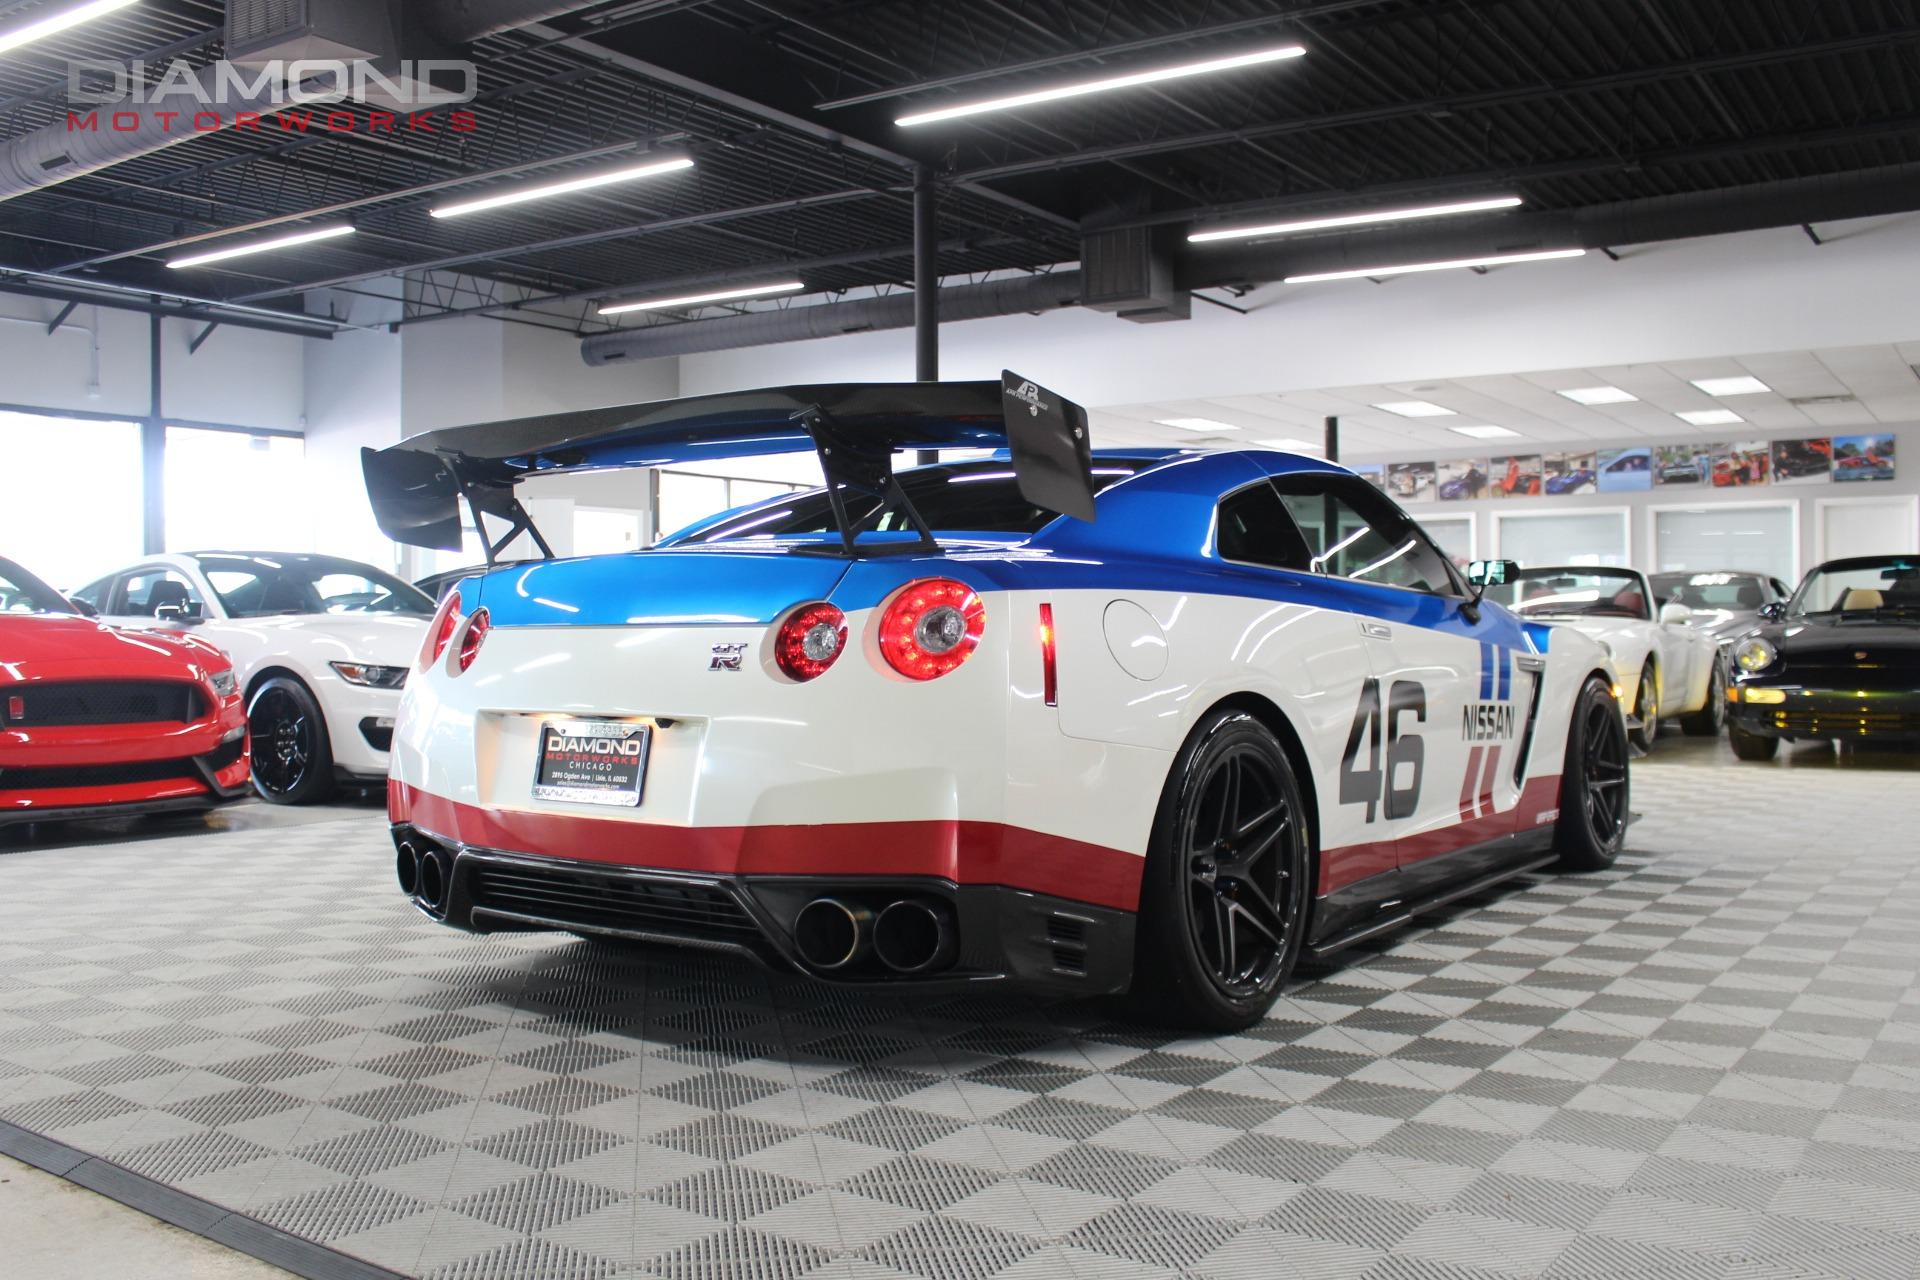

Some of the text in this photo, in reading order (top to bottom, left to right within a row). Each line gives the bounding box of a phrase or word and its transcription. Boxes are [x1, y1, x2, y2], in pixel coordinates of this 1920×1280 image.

[1462, 705, 1515, 741] NISSAN
[547, 736, 641, 756] DIAMOND
[1339, 677, 1427, 824] 46
[545, 752, 639, 765] MOTORWORKS
[569, 761, 612, 771] CHICAGO
